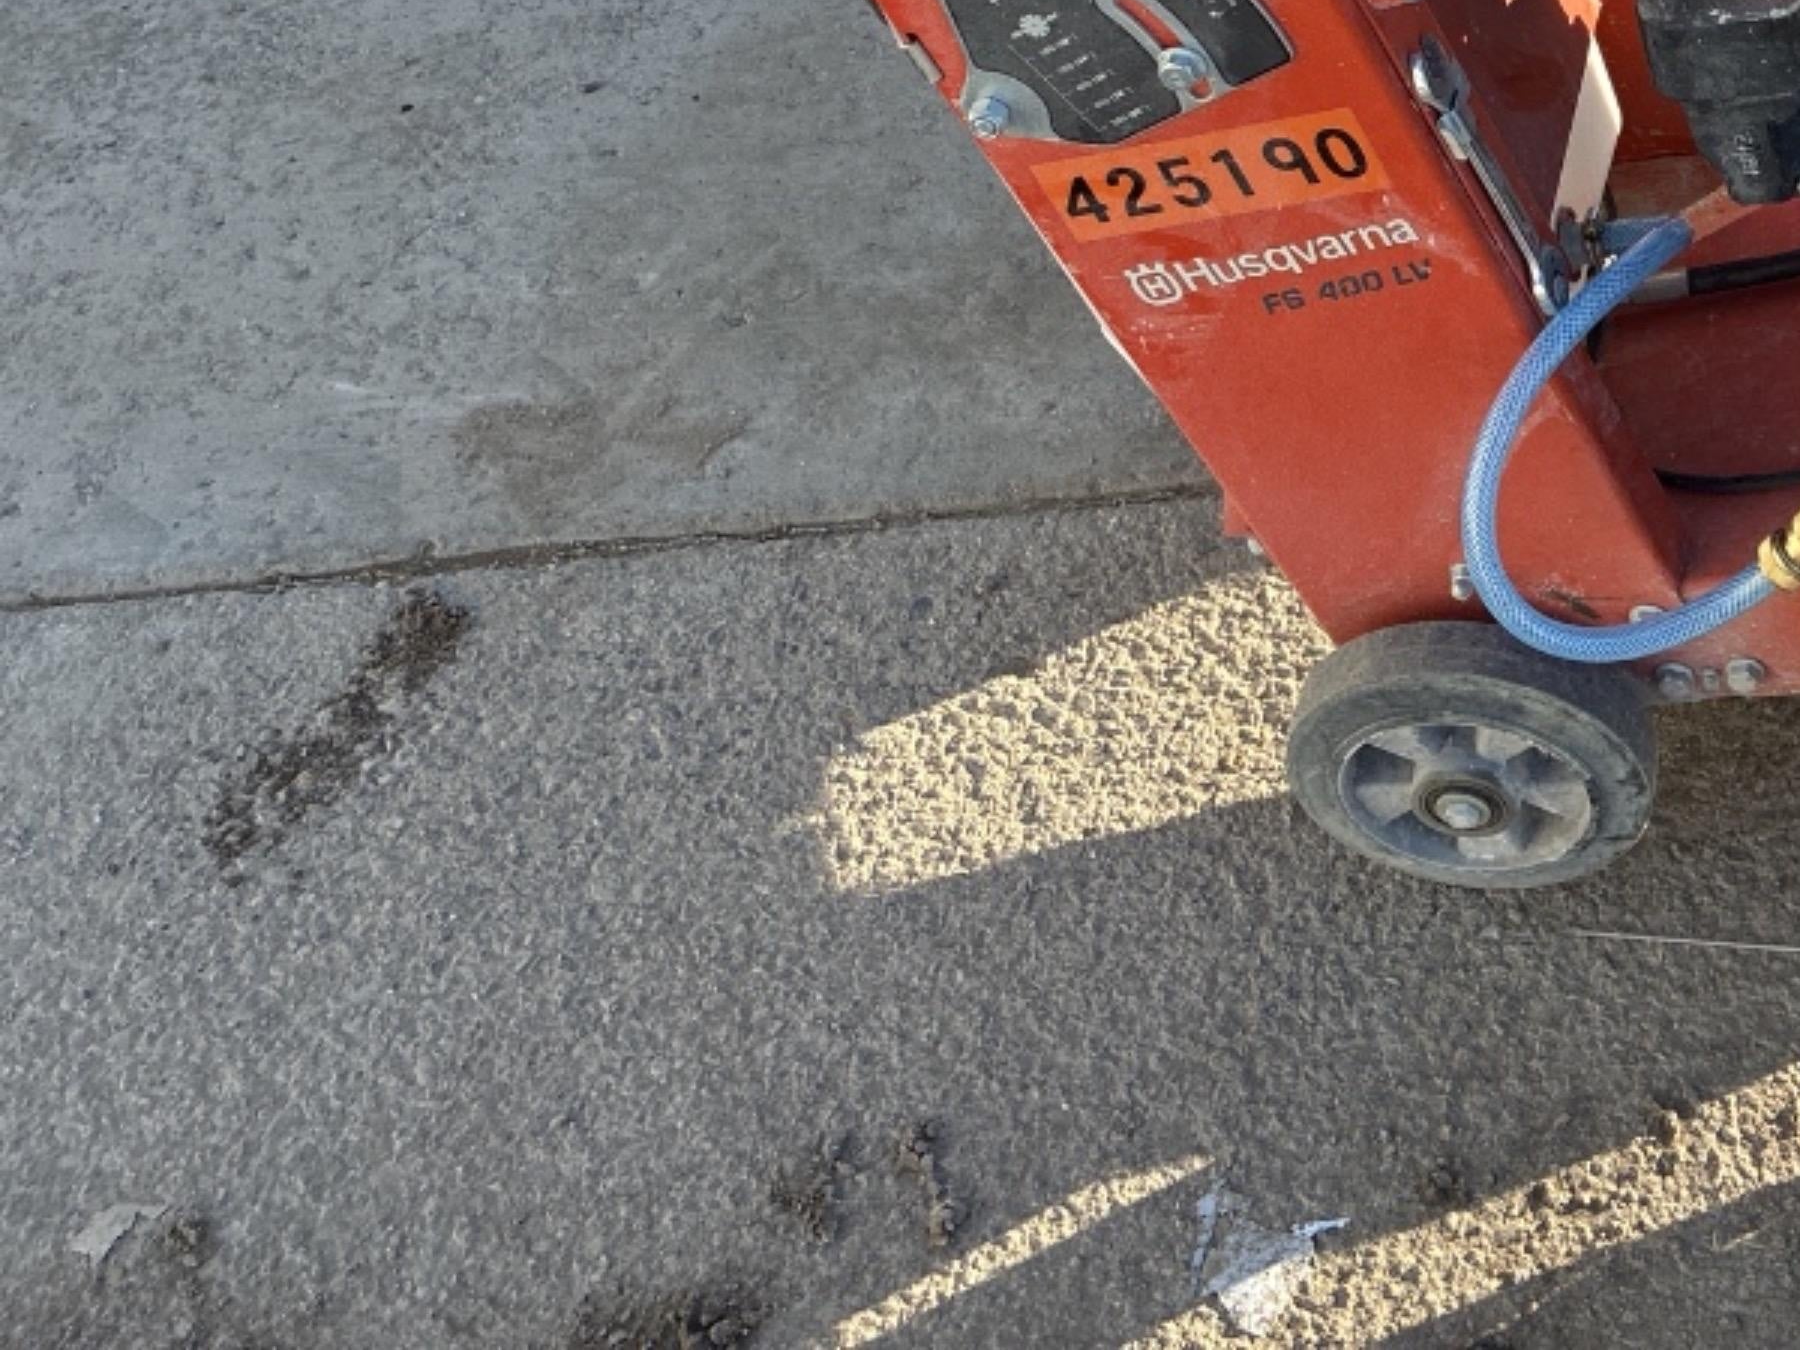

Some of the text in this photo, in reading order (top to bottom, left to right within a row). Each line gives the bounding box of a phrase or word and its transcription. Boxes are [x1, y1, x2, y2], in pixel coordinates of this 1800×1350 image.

[1065, 127, 1369, 224] 425190
[1173, 216, 1420, 293] Husqvarna
[1262, 258, 1433, 315] FS 400 LV
